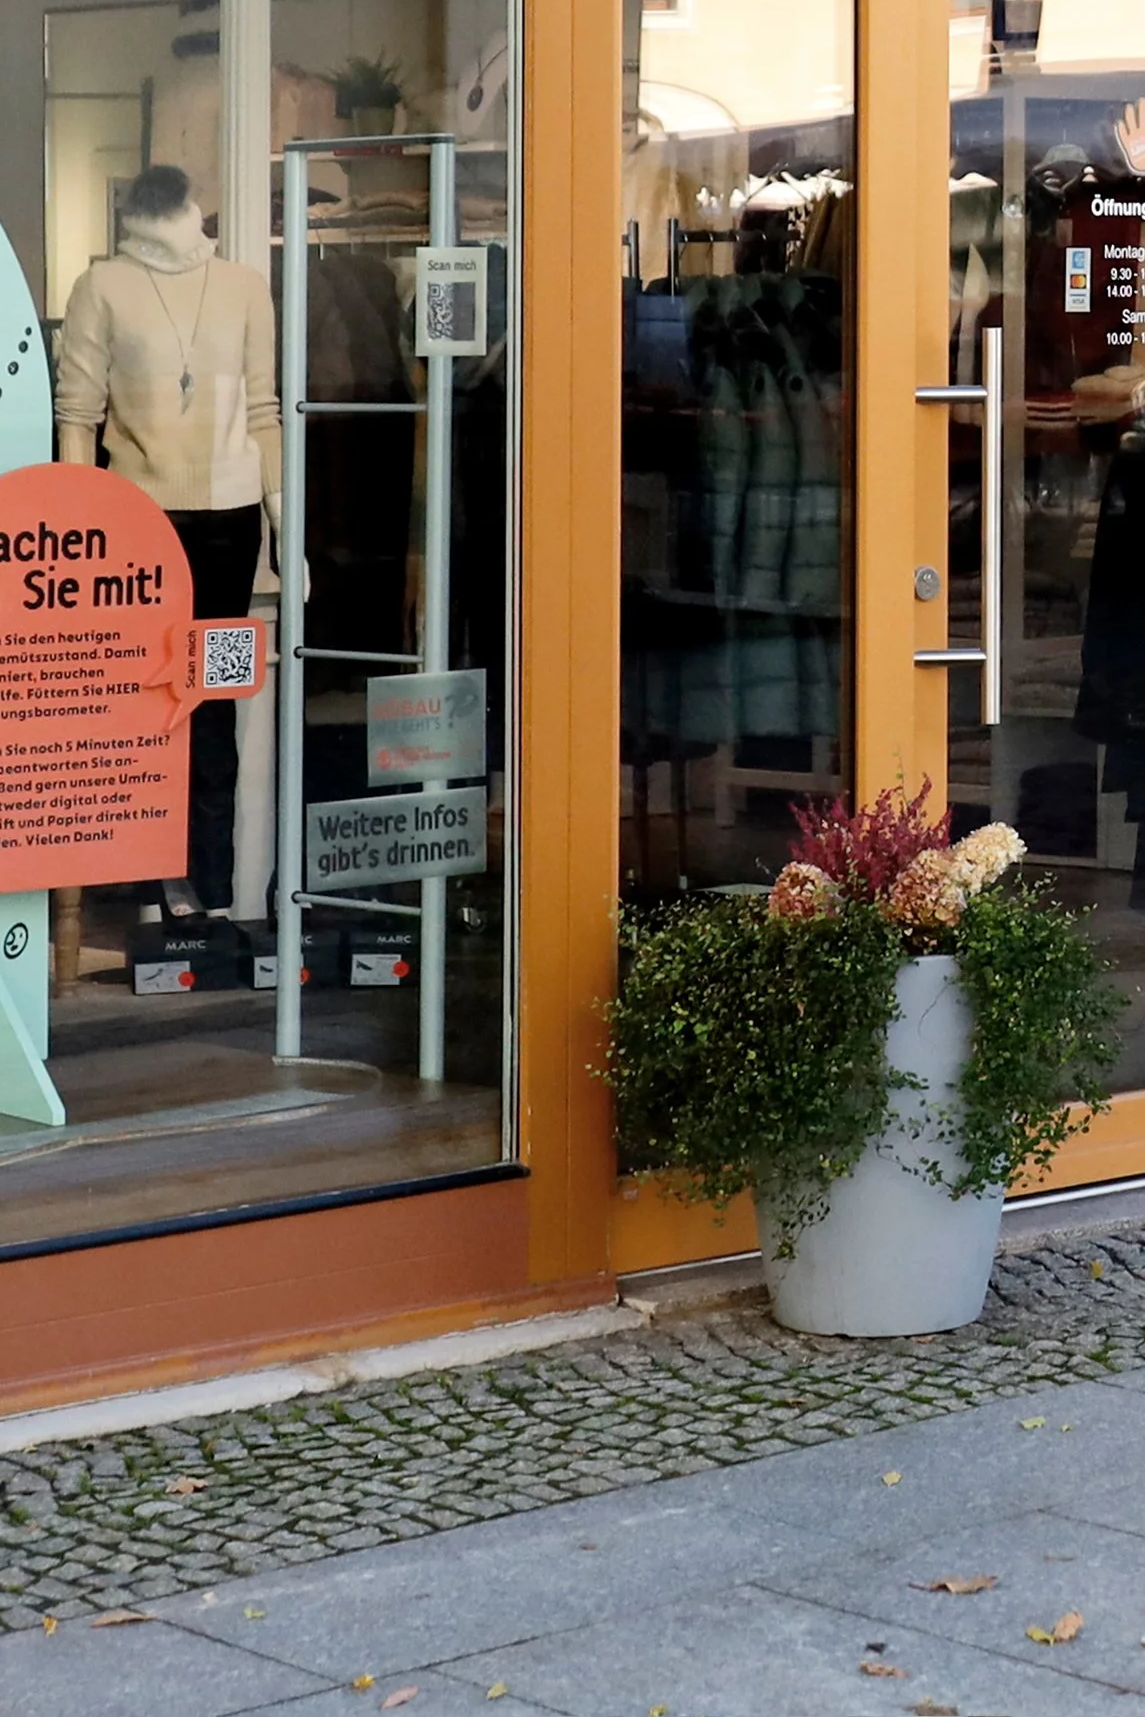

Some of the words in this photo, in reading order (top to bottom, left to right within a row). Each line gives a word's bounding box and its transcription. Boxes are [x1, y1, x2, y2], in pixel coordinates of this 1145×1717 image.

[427, 259, 451, 271] Scan
[1110, 267, 1133, 281] 9.30
[1106, 284, 1133, 298] 14.00
[1106, 332, 1133, 345] 10.00
[23, 565, 79, 610] Sie
[93, 562, 162, 607] mit!
[5, 633, 26, 645] Sie
[29, 633, 55, 644] den
[58, 629, 120, 644] heutigen
[186, 629, 197, 657] mich
[104, 645, 146, 659] Damit
[39, 667, 104, 680] brauchen
[185, 661, 196, 689] Scan
[27, 688, 79, 699] Füttern
[82, 684, 103, 696] Sie
[106, 682, 140, 694] HIER
[5, 743, 27, 756] Sie
[30, 742, 62, 754] noch
[66, 740, 72, 752] 5
[76, 738, 133, 751] Minuten
[137, 734, 170, 747] Zeit?
[91, 756, 112, 769] Sie
[114, 757, 138, 767] an-
[35, 780, 66, 794] gern
[69, 776, 115, 788] unsere
[118, 771, 167, 784] Umfra-
[49, 793, 97, 810] digital
[101, 791, 132, 804] oder
[18, 816, 44, 828] und
[47, 812, 92, 827] Papier
[95, 809, 137, 822] direkt
[141, 806, 168, 818] hier
[318, 810, 408, 841] Weitere
[415, 803, 469, 832] Infos
[25, 833, 70, 846] Vielen
[73, 828, 113, 842] Dank!
[318, 842, 380, 878] gibt's
[387, 835, 476, 867] drinnen.
[164, 939, 207, 951] MARC
[376, 935, 412, 944] MARC
